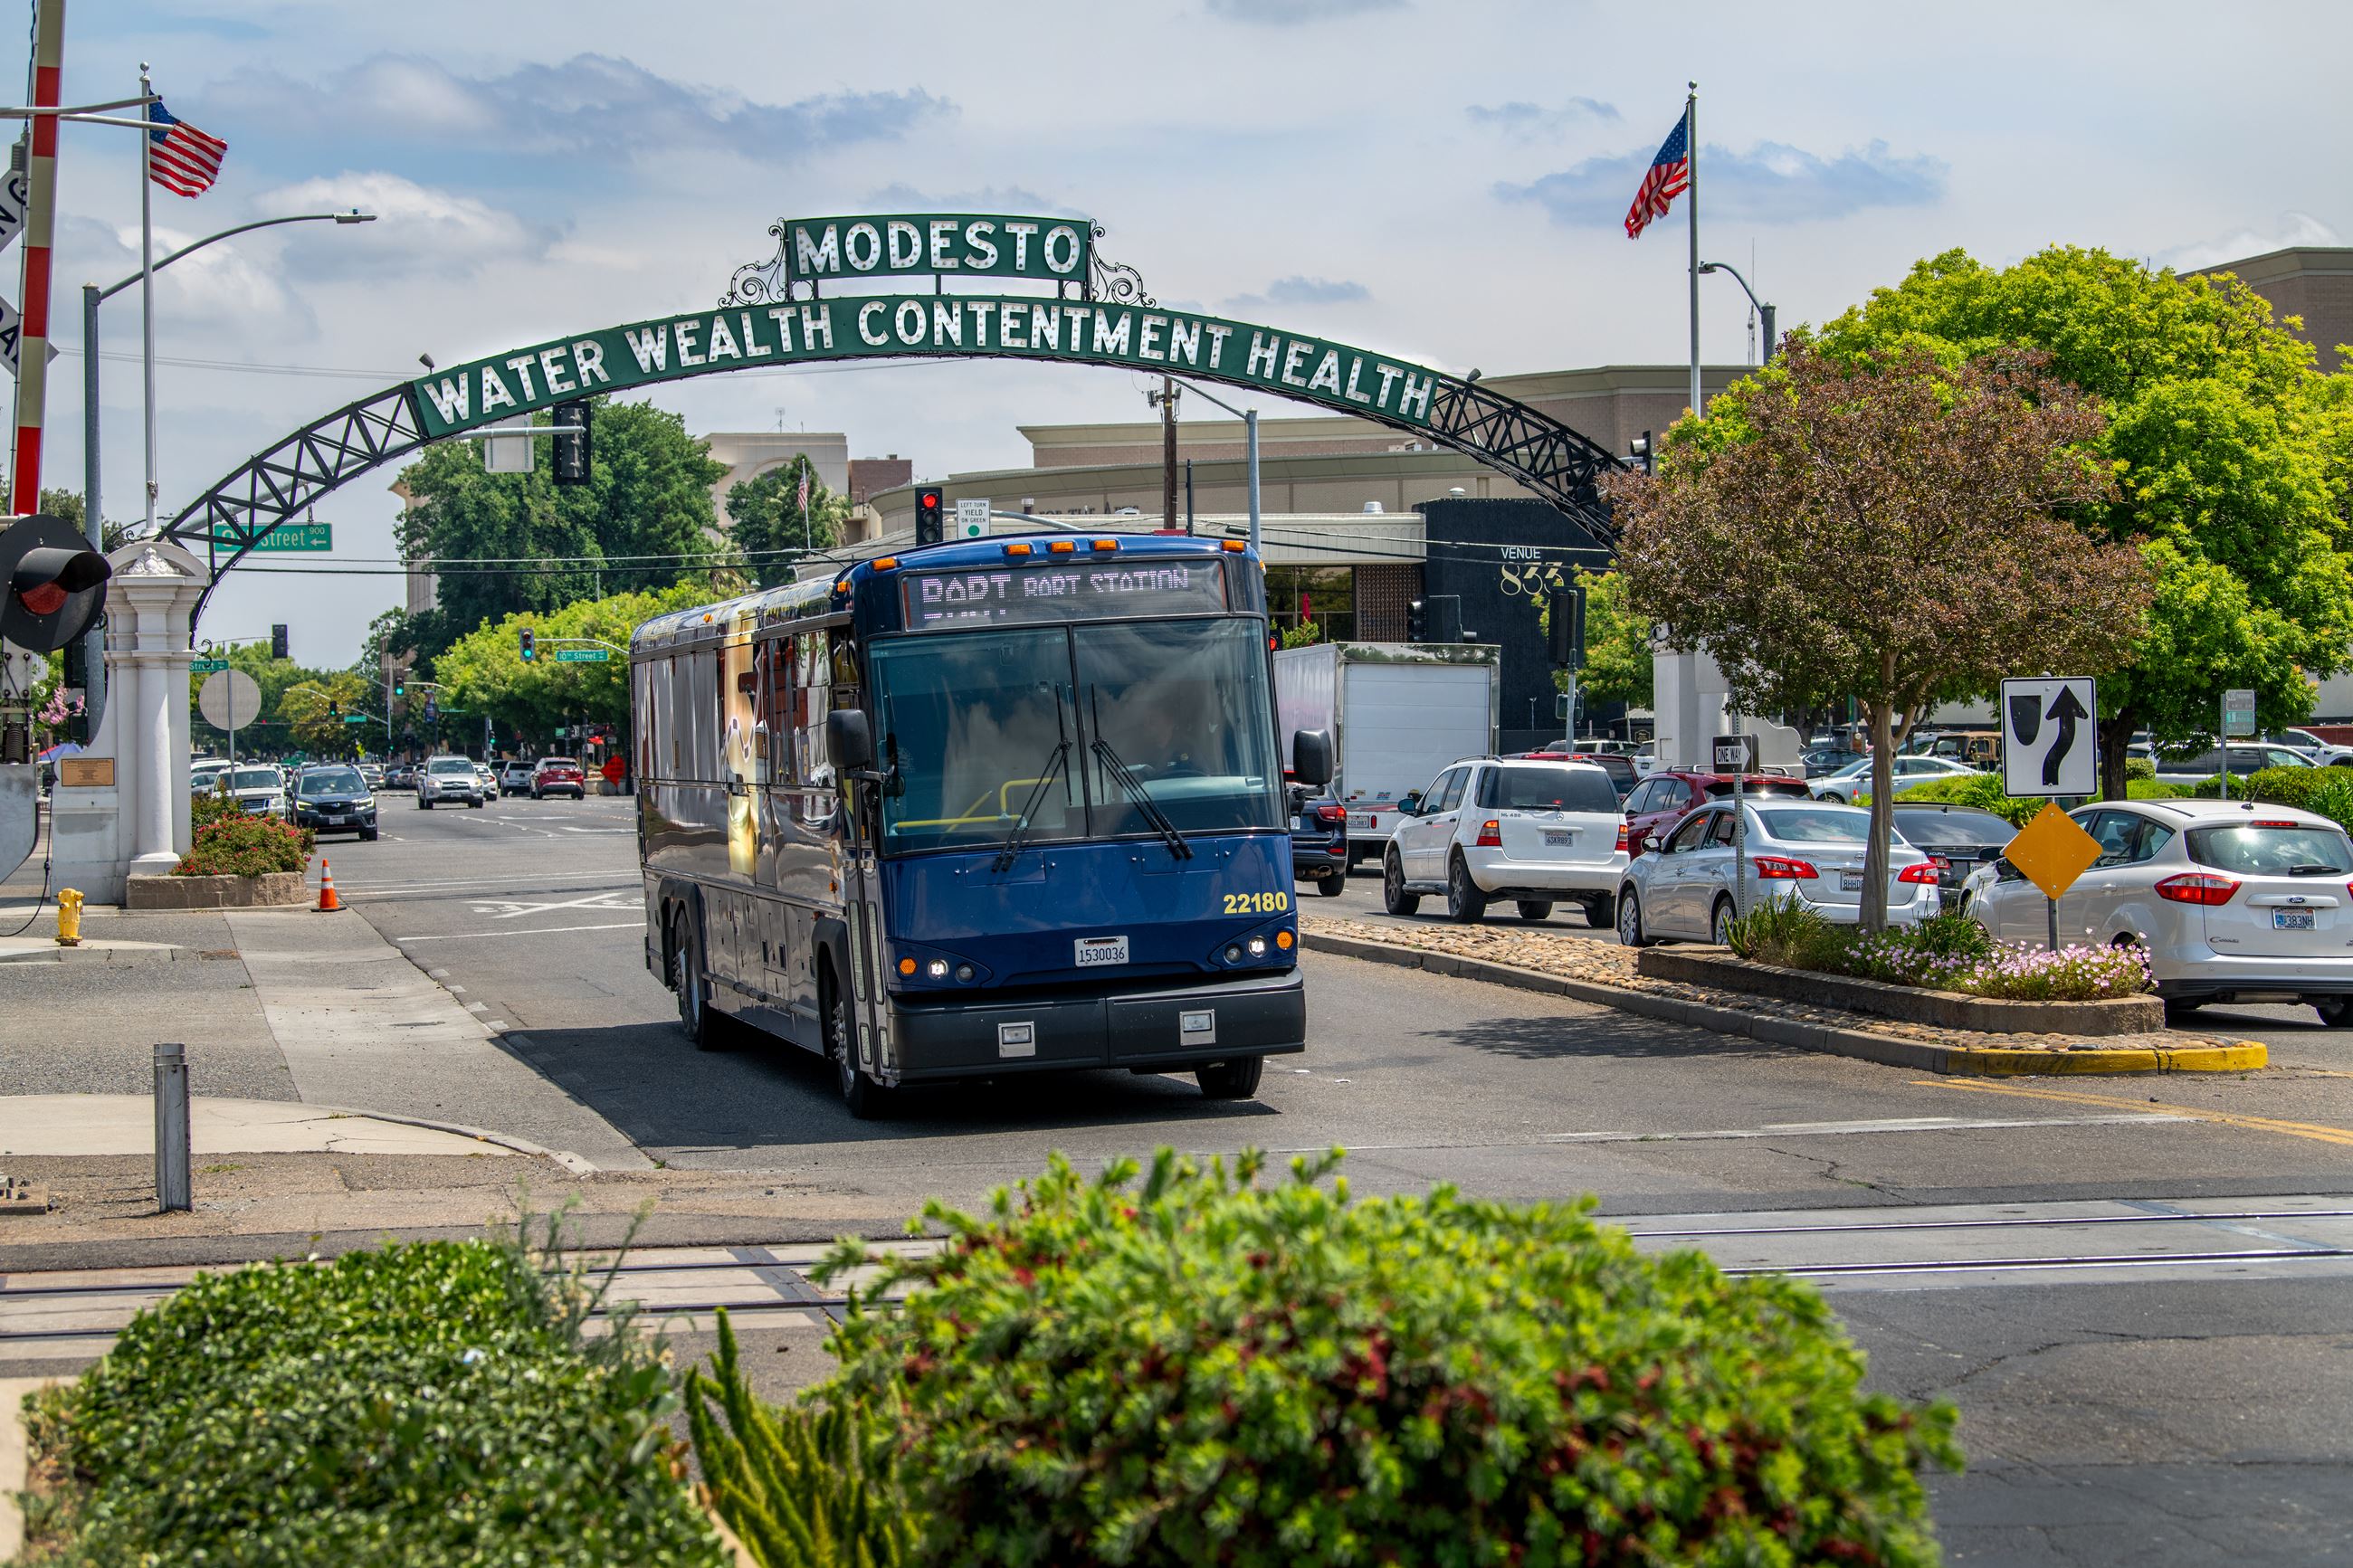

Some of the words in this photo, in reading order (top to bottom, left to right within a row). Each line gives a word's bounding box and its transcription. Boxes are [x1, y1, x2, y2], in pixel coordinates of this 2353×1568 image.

[795, 220, 1081, 274] MODESTO
[423, 339, 610, 424] WATER
[624, 304, 833, 373] WEALTH
[859, 300, 1233, 368] CONTENTMENT
[1246, 331, 1433, 419] HEALTH
[260, 529, 305, 547] Street
[309, 527, 326, 535] 900
[1500, 547, 1541, 559] VENUE
[1717, 747, 1729, 763] ONE
[1730, 747, 1741, 763] WAY
[1223, 891, 1288, 915] 22180
[1079, 946, 1125, 963] 1530036
